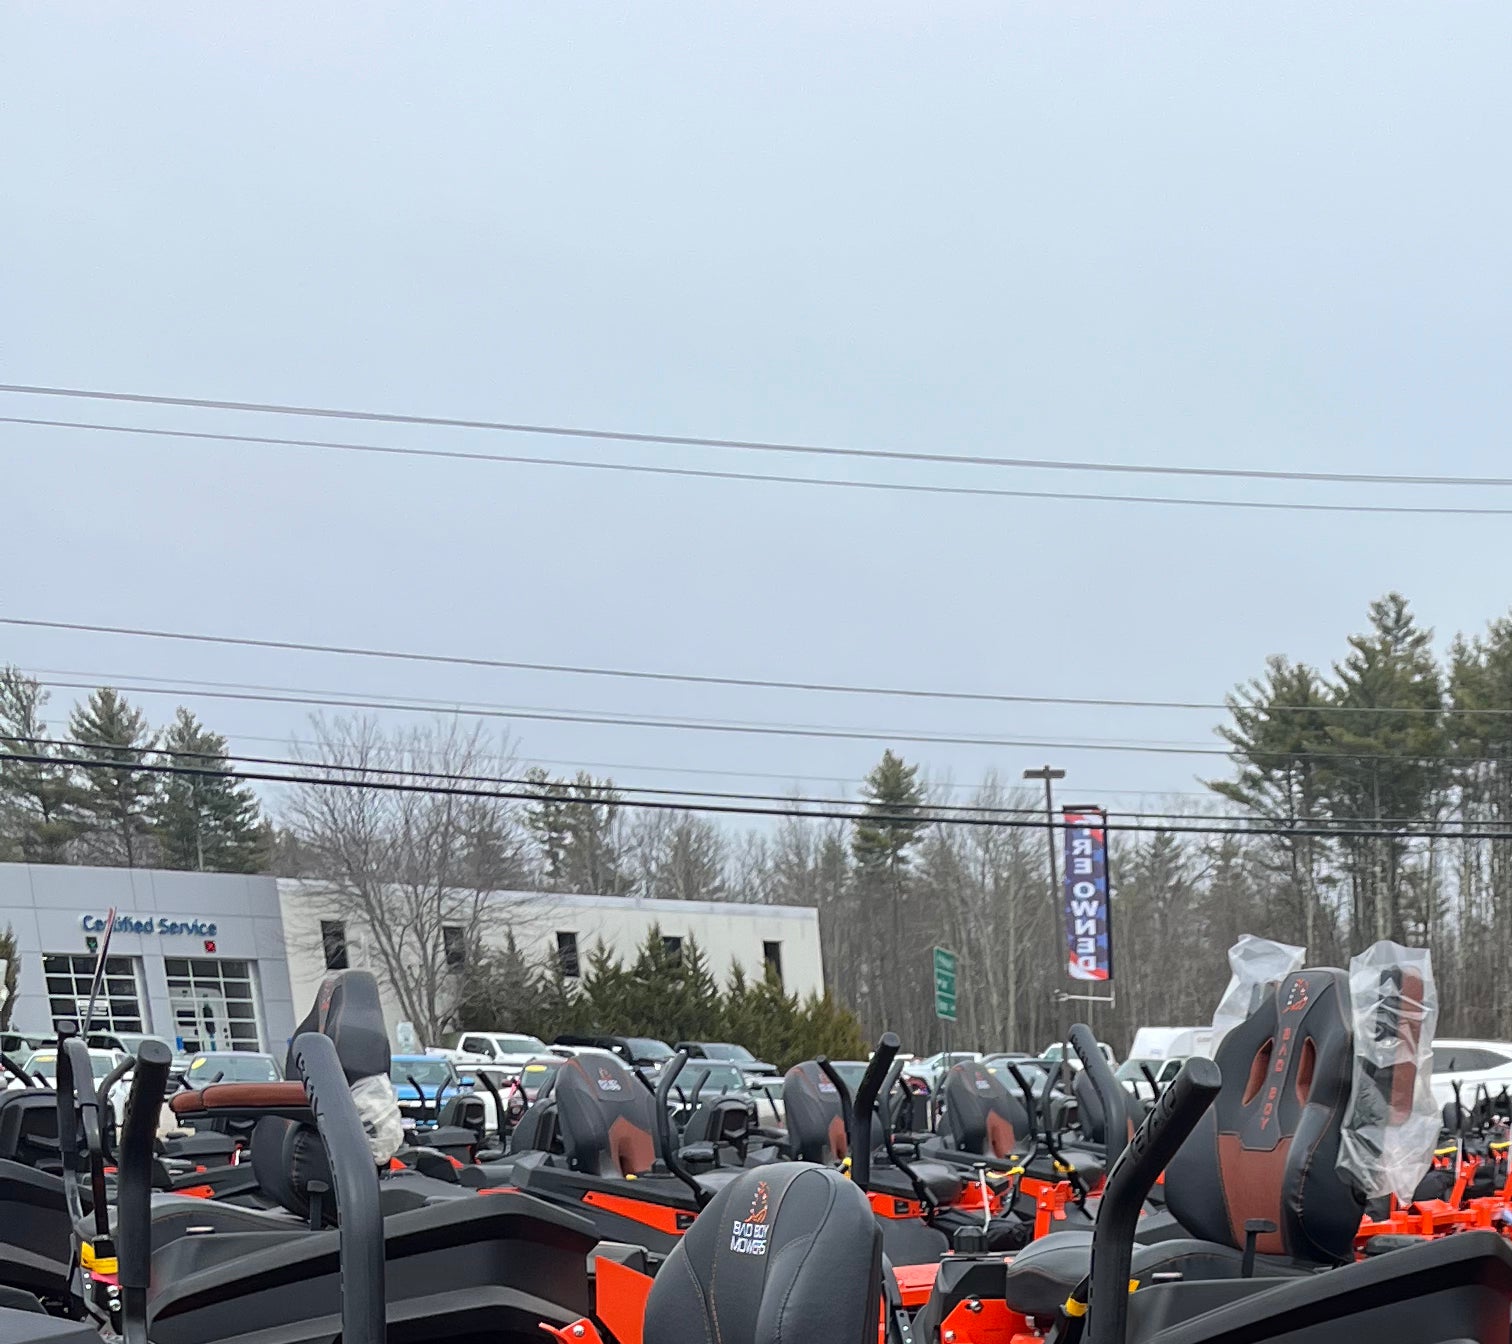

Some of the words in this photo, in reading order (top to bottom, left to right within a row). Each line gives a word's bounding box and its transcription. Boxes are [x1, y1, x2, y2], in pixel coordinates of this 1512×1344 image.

[158, 918, 217, 936] Service
[733, 1220, 753, 1237] BAD
[753, 1224, 770, 1238] BOY
